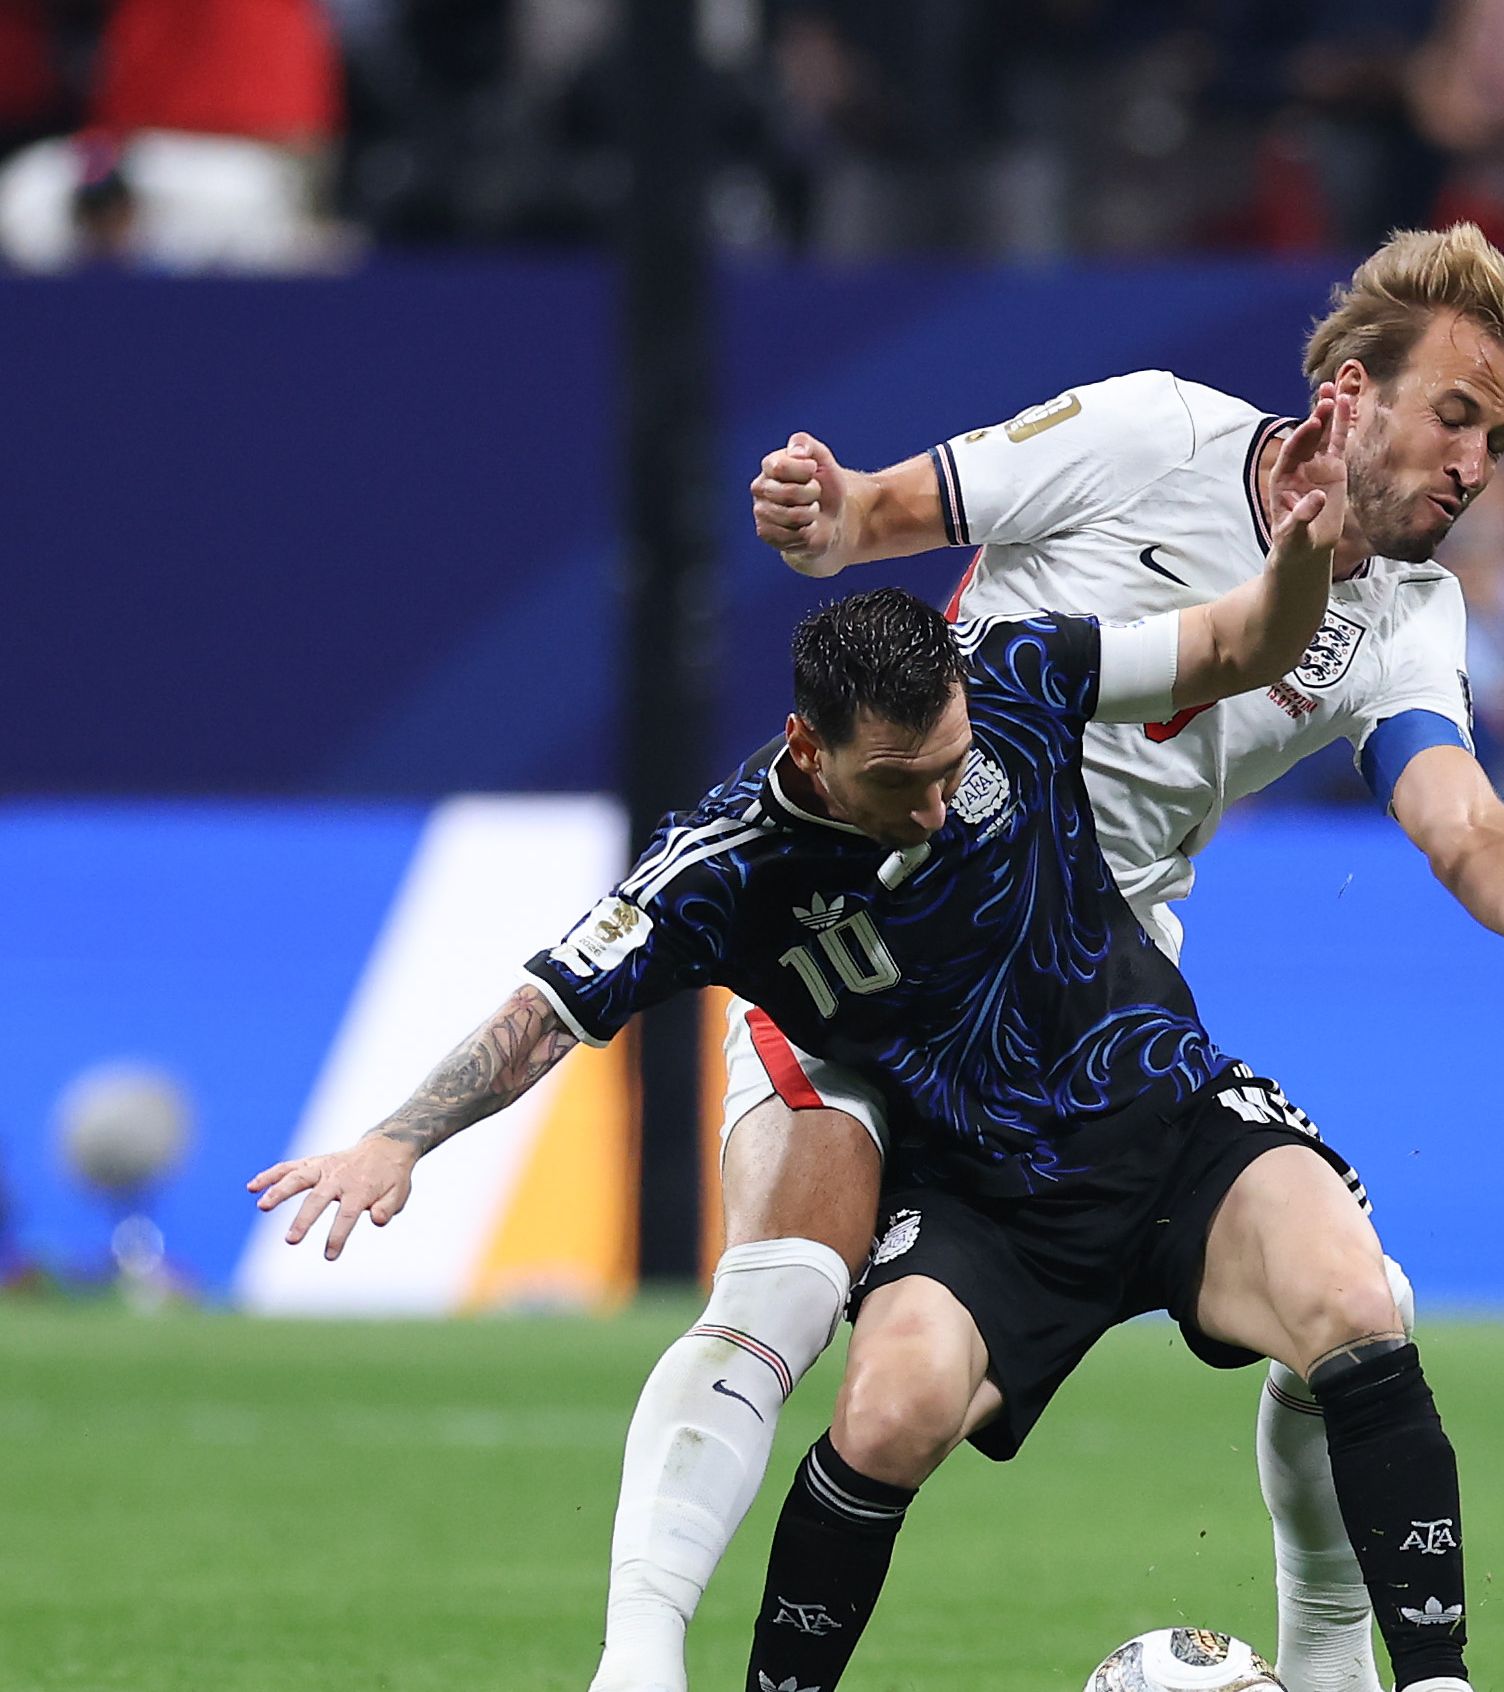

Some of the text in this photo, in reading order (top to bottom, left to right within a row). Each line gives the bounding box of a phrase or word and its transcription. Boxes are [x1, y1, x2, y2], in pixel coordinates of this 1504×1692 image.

[963, 771, 993, 806] AFA
[778, 909, 902, 1019] 10
[1399, 1518, 1457, 1555] AFA
[772, 1595, 842, 1637] AFA
